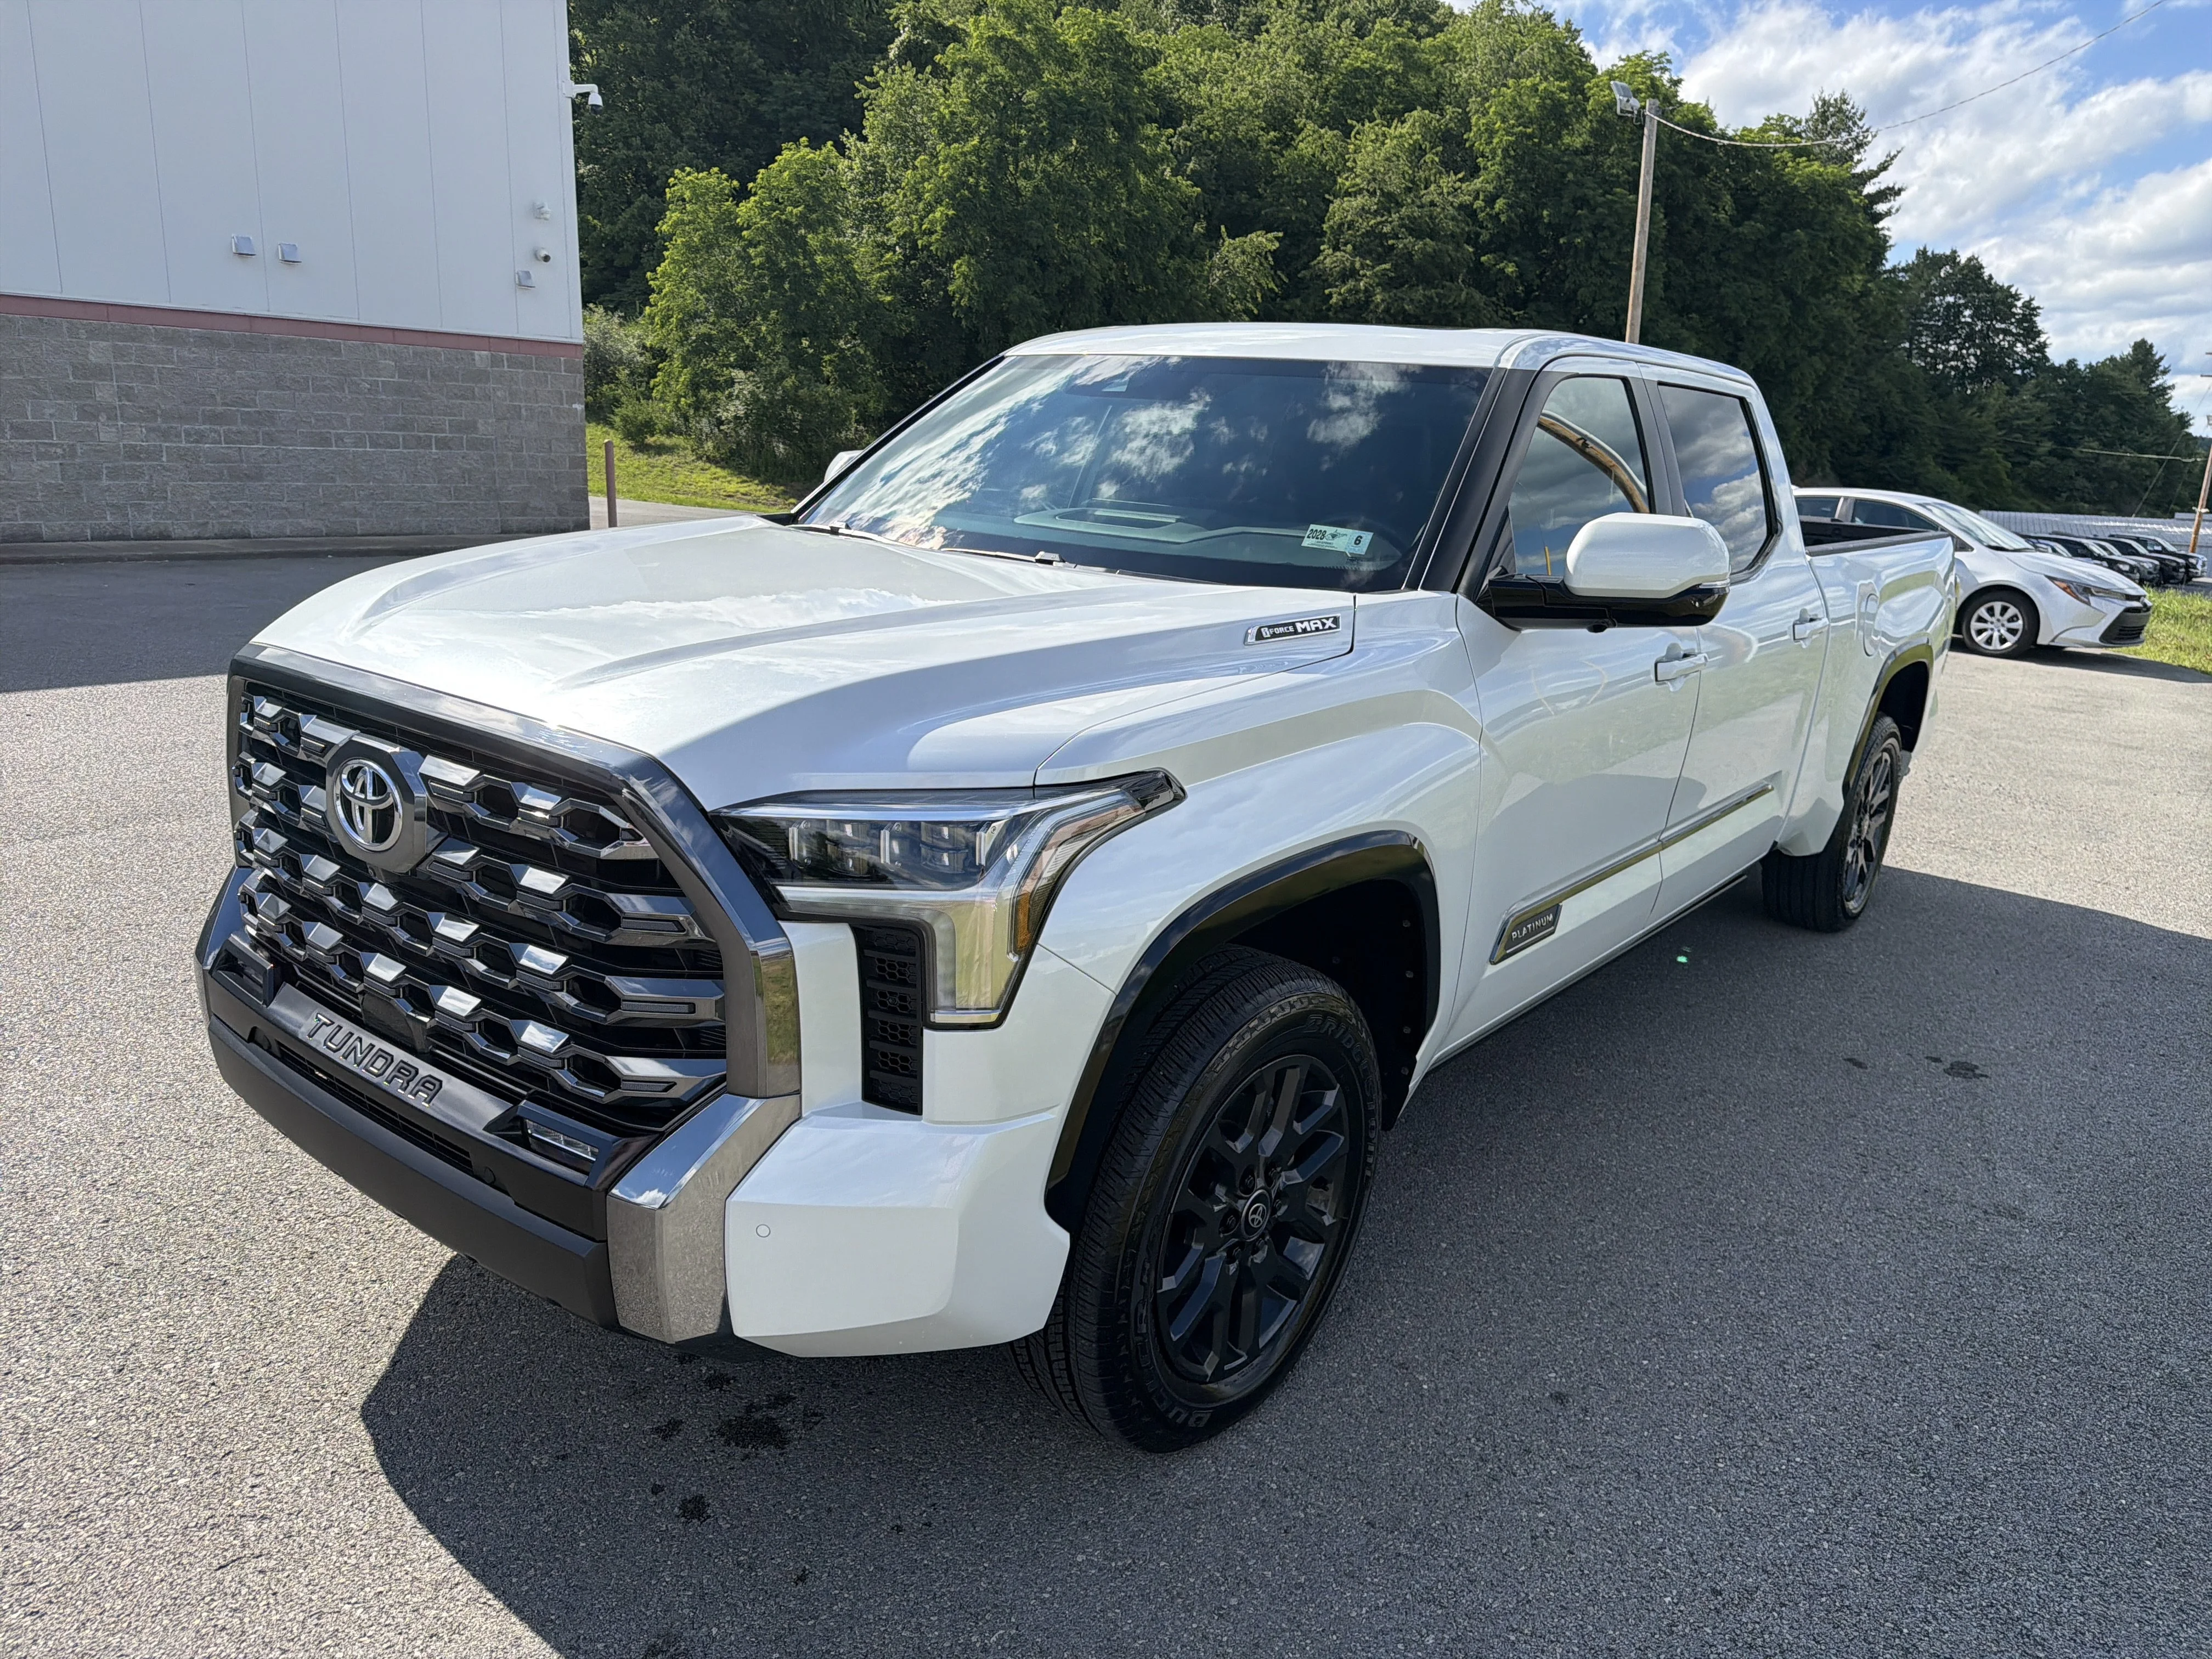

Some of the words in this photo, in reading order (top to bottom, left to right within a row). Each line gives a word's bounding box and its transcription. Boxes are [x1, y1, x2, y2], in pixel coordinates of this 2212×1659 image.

[1307, 528, 1327, 540] 2028
[1354, 535, 1363, 545] 6
[1295, 618, 1336, 633] MAX
[1511, 913, 1553, 942] PLATINUM
[307, 1012, 443, 1108] TUNDRA
